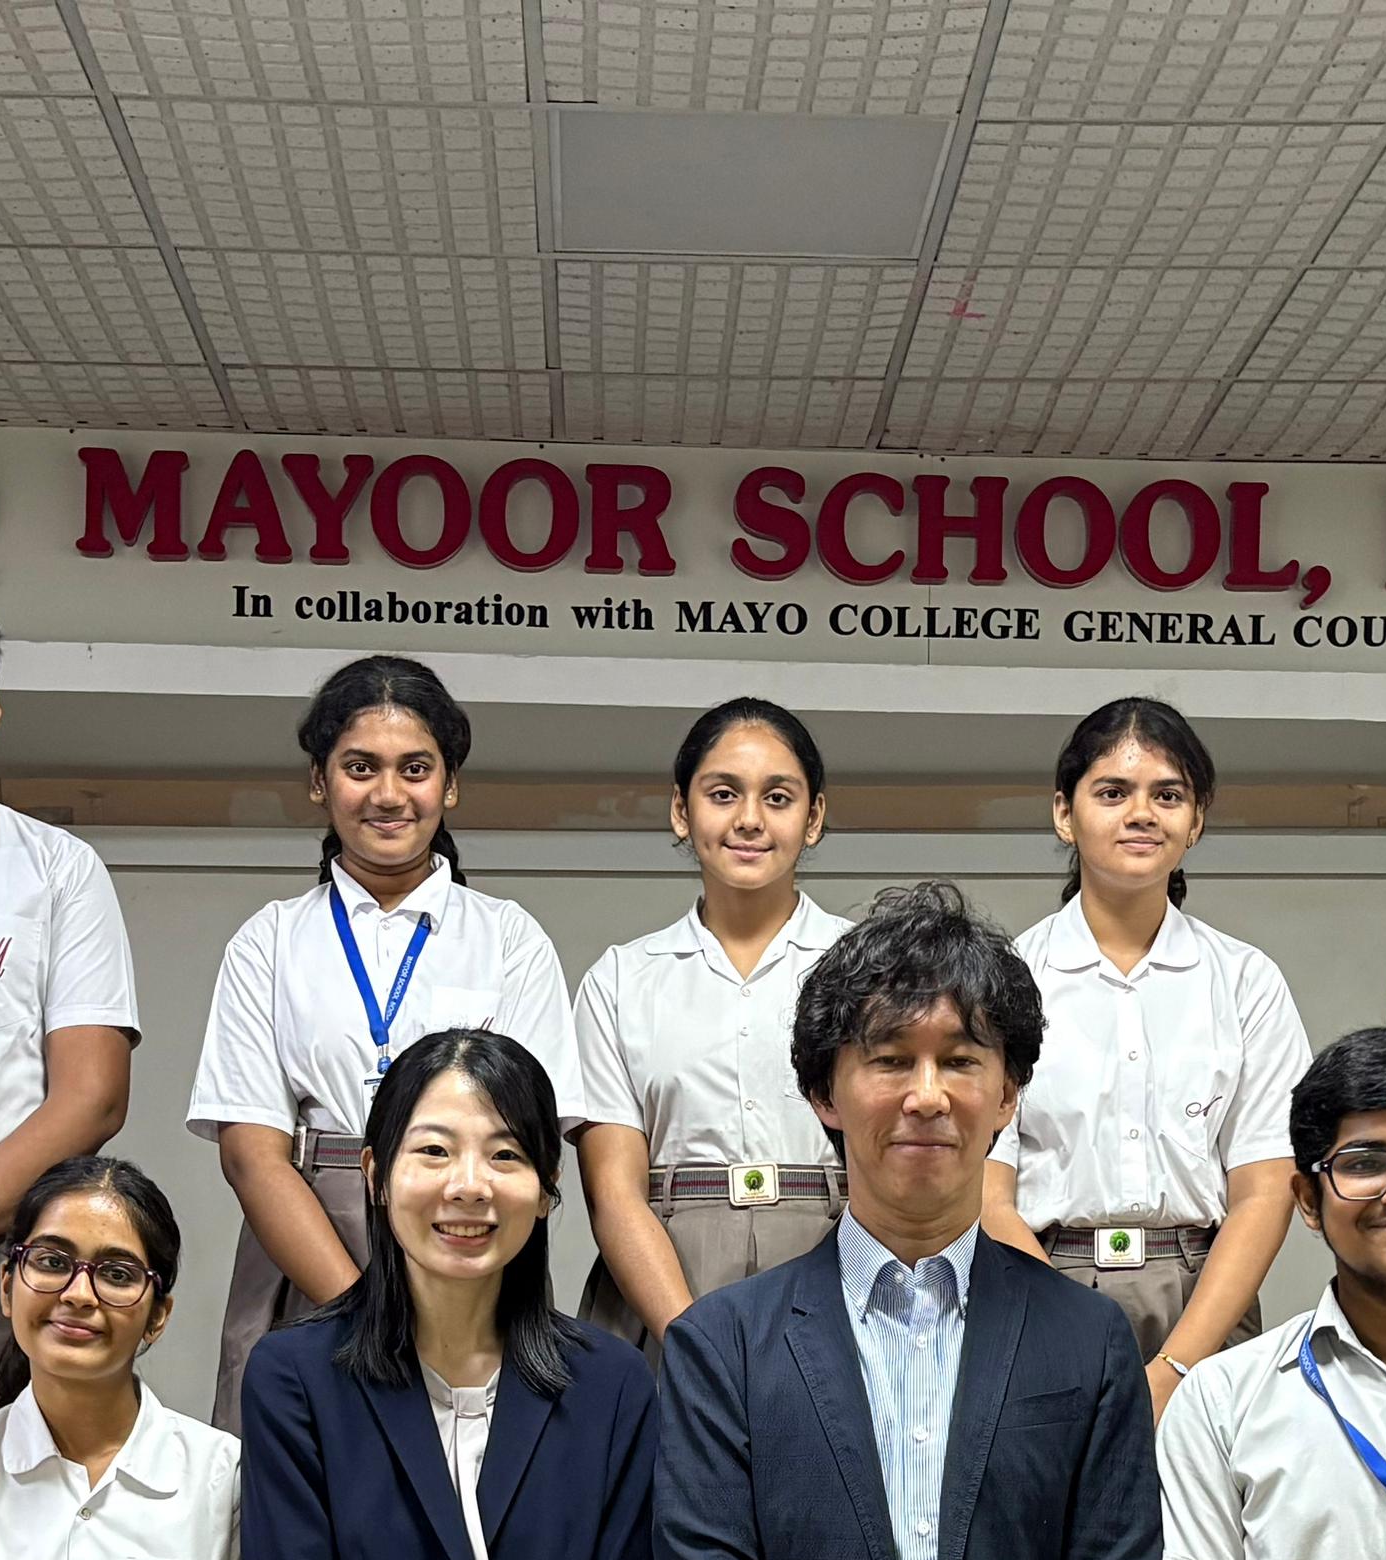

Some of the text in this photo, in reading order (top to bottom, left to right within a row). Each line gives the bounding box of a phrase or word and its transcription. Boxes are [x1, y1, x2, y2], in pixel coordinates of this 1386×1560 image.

[76, 447, 677, 577] MAYOOR
[731, 466, 1332, 609] SCHOOL,
[232, 585, 274, 619] In
[295, 590, 550, 629] collaboration
[570, 597, 655, 632] with
[674, 602, 809, 636] MAYO
[829, 603, 1041, 641] COLLEGE
[1063, 610, 1277, 647] GENERAL
